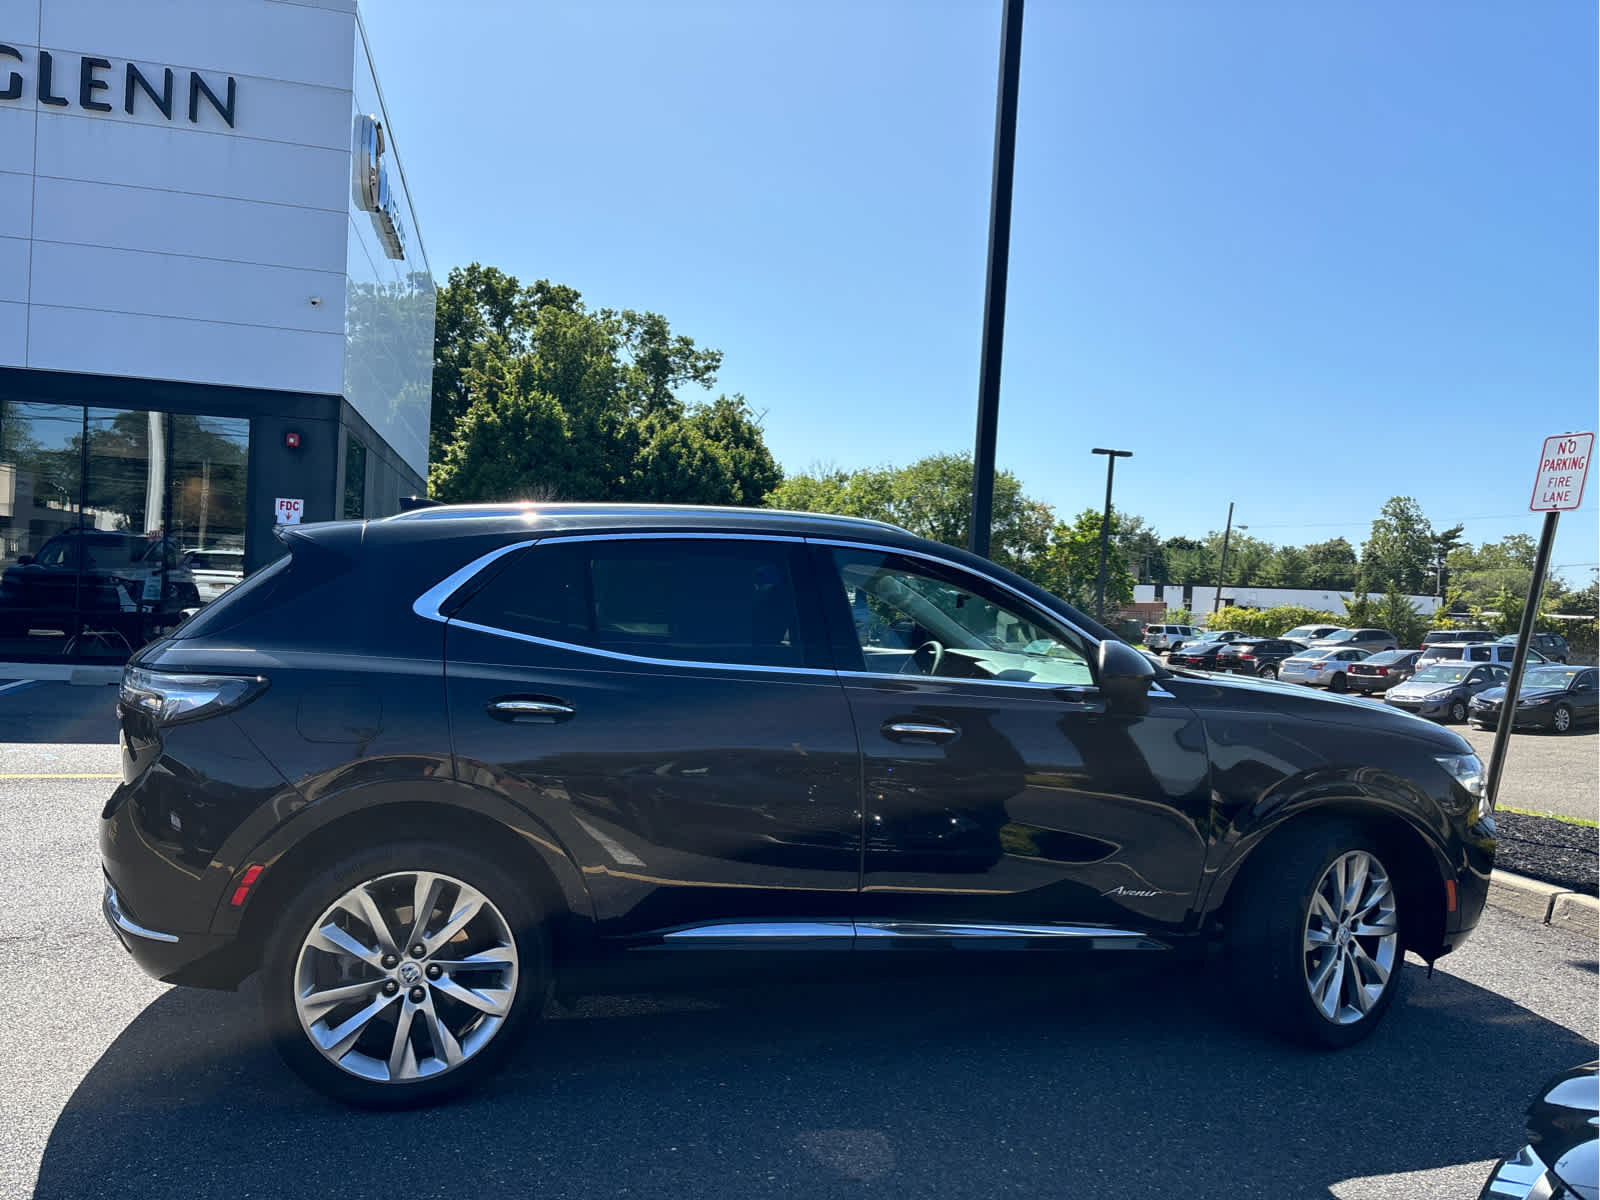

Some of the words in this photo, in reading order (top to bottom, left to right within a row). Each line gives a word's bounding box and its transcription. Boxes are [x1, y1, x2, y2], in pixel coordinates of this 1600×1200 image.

[1557, 440, 1577, 455] NO
[1543, 456, 1585, 472] PARKING
[1547, 476, 1572, 488] FIRE
[1543, 490, 1572, 502] LANE
[280, 501, 299, 511] FDC
[1101, 886, 1163, 896] Avenir
